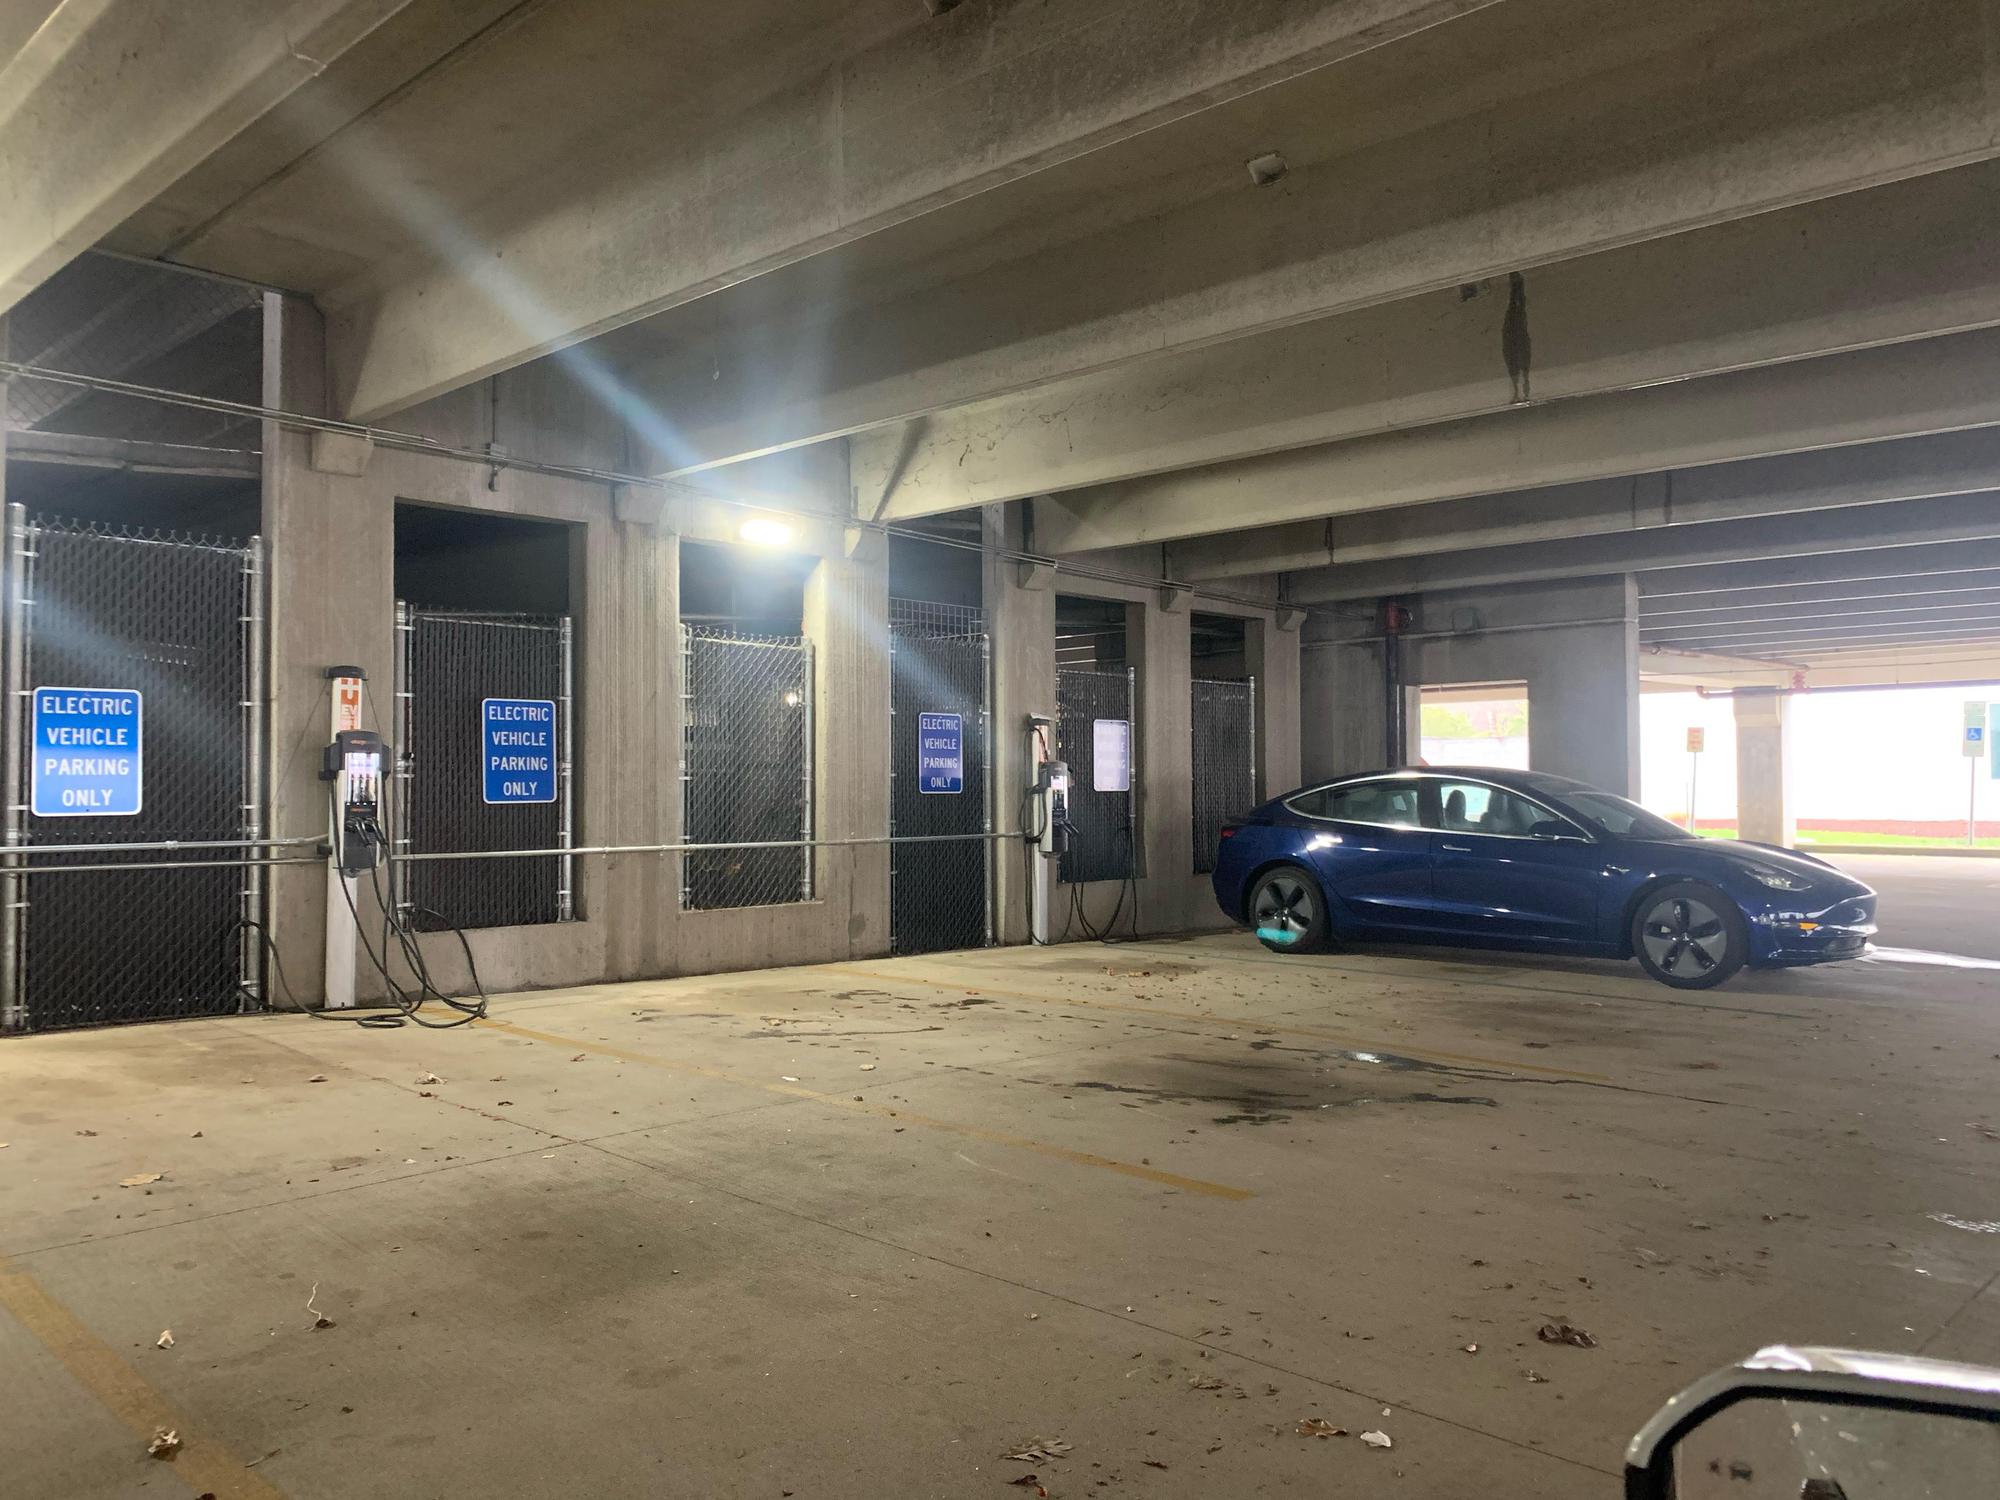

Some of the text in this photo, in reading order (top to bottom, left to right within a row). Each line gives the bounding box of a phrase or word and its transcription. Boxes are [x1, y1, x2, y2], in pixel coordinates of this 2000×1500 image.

[42, 696, 133, 715] ELECTRIC
[489, 706, 549, 721] ELECTRIC
[922, 718, 958, 730] ELECTRIC
[47, 727, 128, 745] VEHICLE
[492, 731, 546, 746] VEHICLE
[924, 738, 957, 750] VEHICLE
[45, 758, 129, 775] PARKING
[491, 756, 548, 771] PARKING
[924, 757, 958, 769] PARKING
[503, 782, 537, 796] ONLY
[931, 777, 951, 788] ONLY
[62, 789, 113, 807] ONLY
